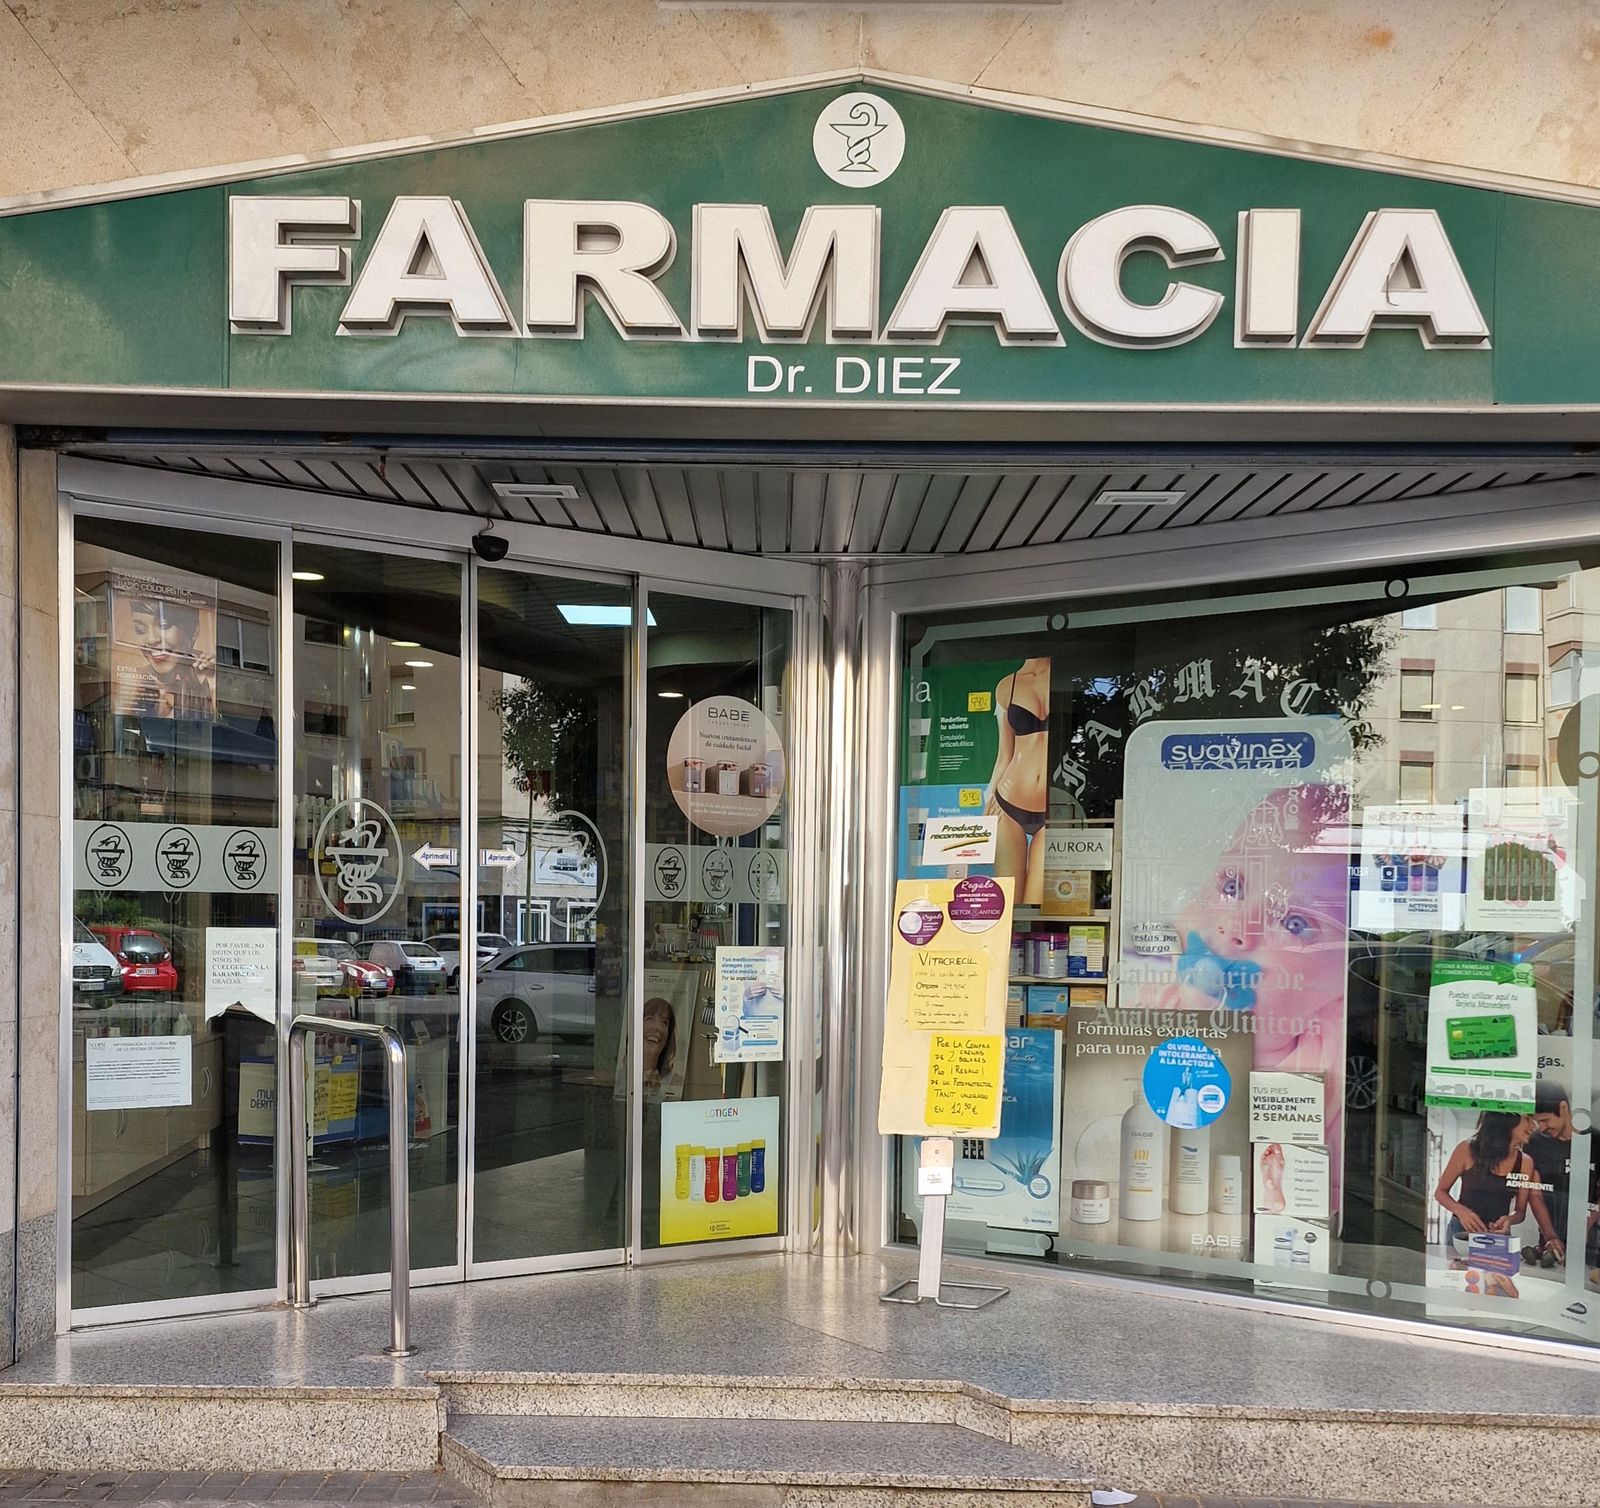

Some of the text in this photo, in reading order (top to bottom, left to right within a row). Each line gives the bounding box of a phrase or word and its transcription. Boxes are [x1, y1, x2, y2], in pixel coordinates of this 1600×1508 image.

[228, 195, 1492, 350] FARMACIA
[746, 355, 961, 395] Dr. DIEZ
[140, 583, 193, 597] COLOURSTICK
[930, 830, 992, 840] recomendado
[941, 824, 983, 834] Producto
[1047, 841, 1104, 853] AURORA
[960, 880, 994, 893] Regalo
[1163, 935, 1178, 943] por
[1134, 944, 1170, 953] ncargo
[1156, 1024, 1228, 1039] expertas
[1075, 1043, 1112, 1057] para
[1115, 1044, 1146, 1056] una
[1166, 1042, 1197, 1053] OLVIDA
[1197, 1045, 1208, 1053] LA
[947, 1050, 955, 1062] 2
[1158, 1049, 1217, 1061] INTOLERANCIA
[1166, 1058, 1177, 1066] LA
[1177, 1059, 1215, 1068] LACTOSA
[1252, 1086, 1289, 1095] TUS PIES
[1252, 1095, 1317, 1105] VISIBLEMENTE
[1252, 1103, 1297, 1112] MEJOR EN
[1252, 1111, 1323, 1124] 2 SEMANAS
[1505, 1172, 1530, 1182] AUTO
[1505, 1179, 1555, 1192] ADHERENTE
